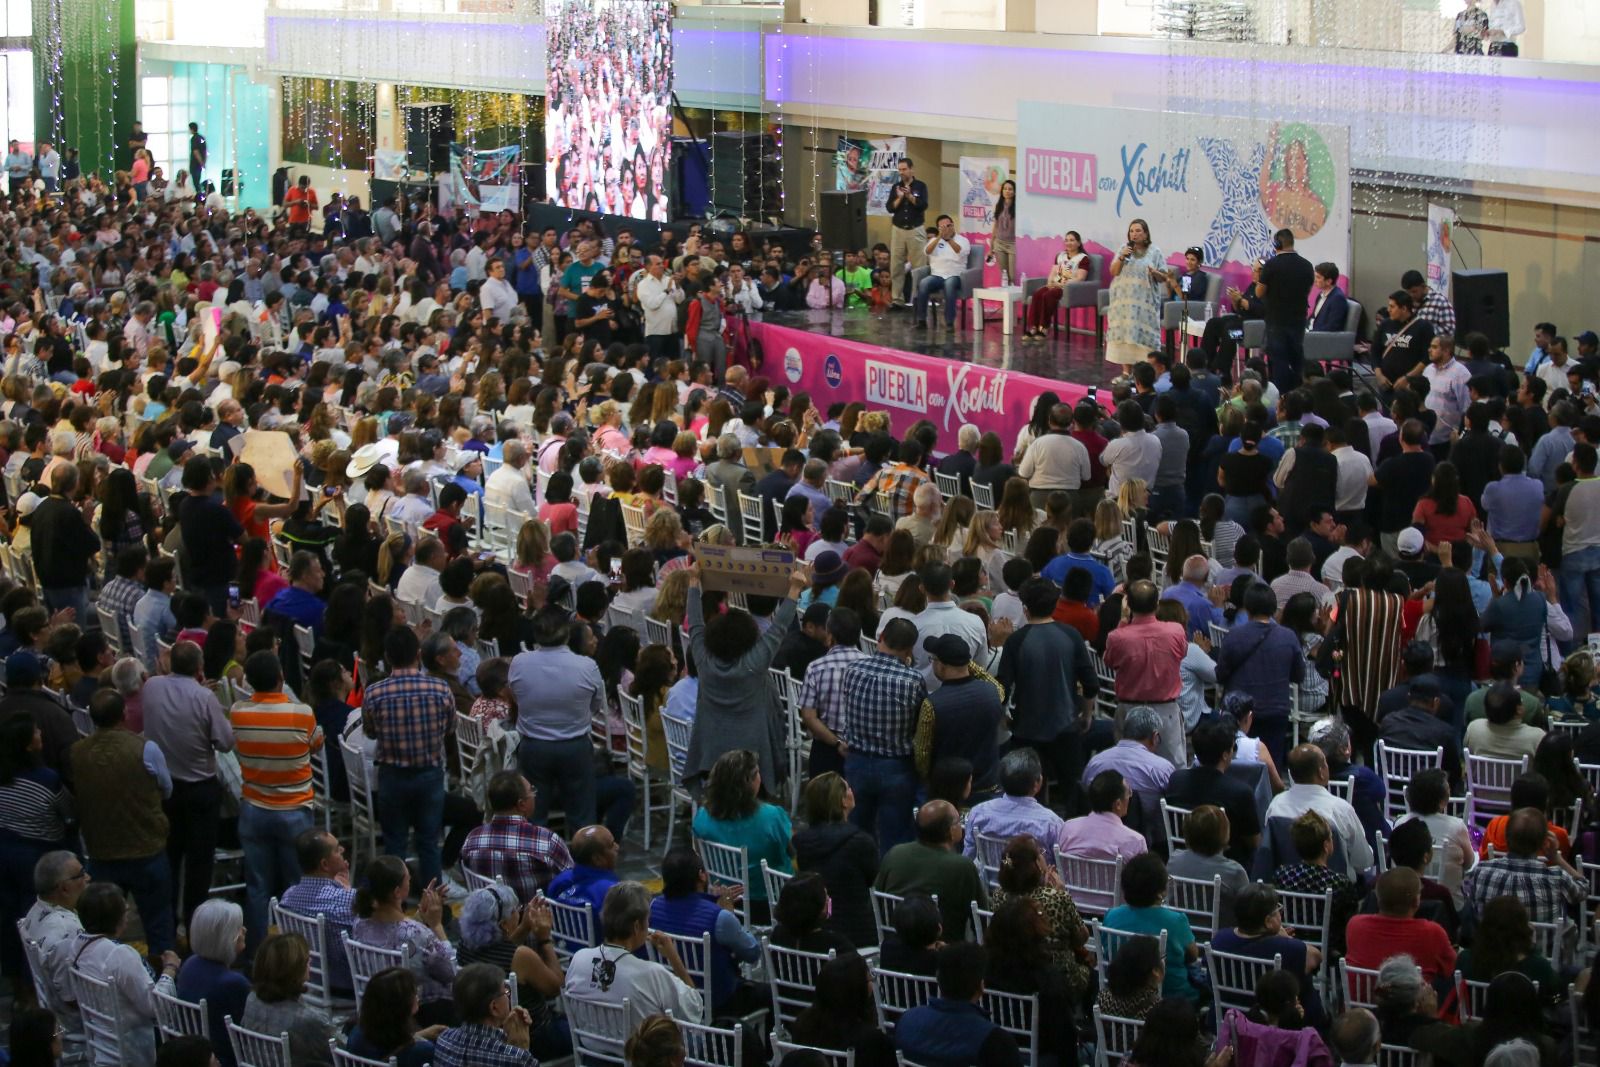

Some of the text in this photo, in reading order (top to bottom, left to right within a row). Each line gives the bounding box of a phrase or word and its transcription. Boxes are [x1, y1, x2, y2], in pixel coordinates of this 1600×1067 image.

[1028, 143, 1190, 218] PUEBLA con Xóchitl
[869, 364, 1008, 433] PUEBLA con Xóchitl
